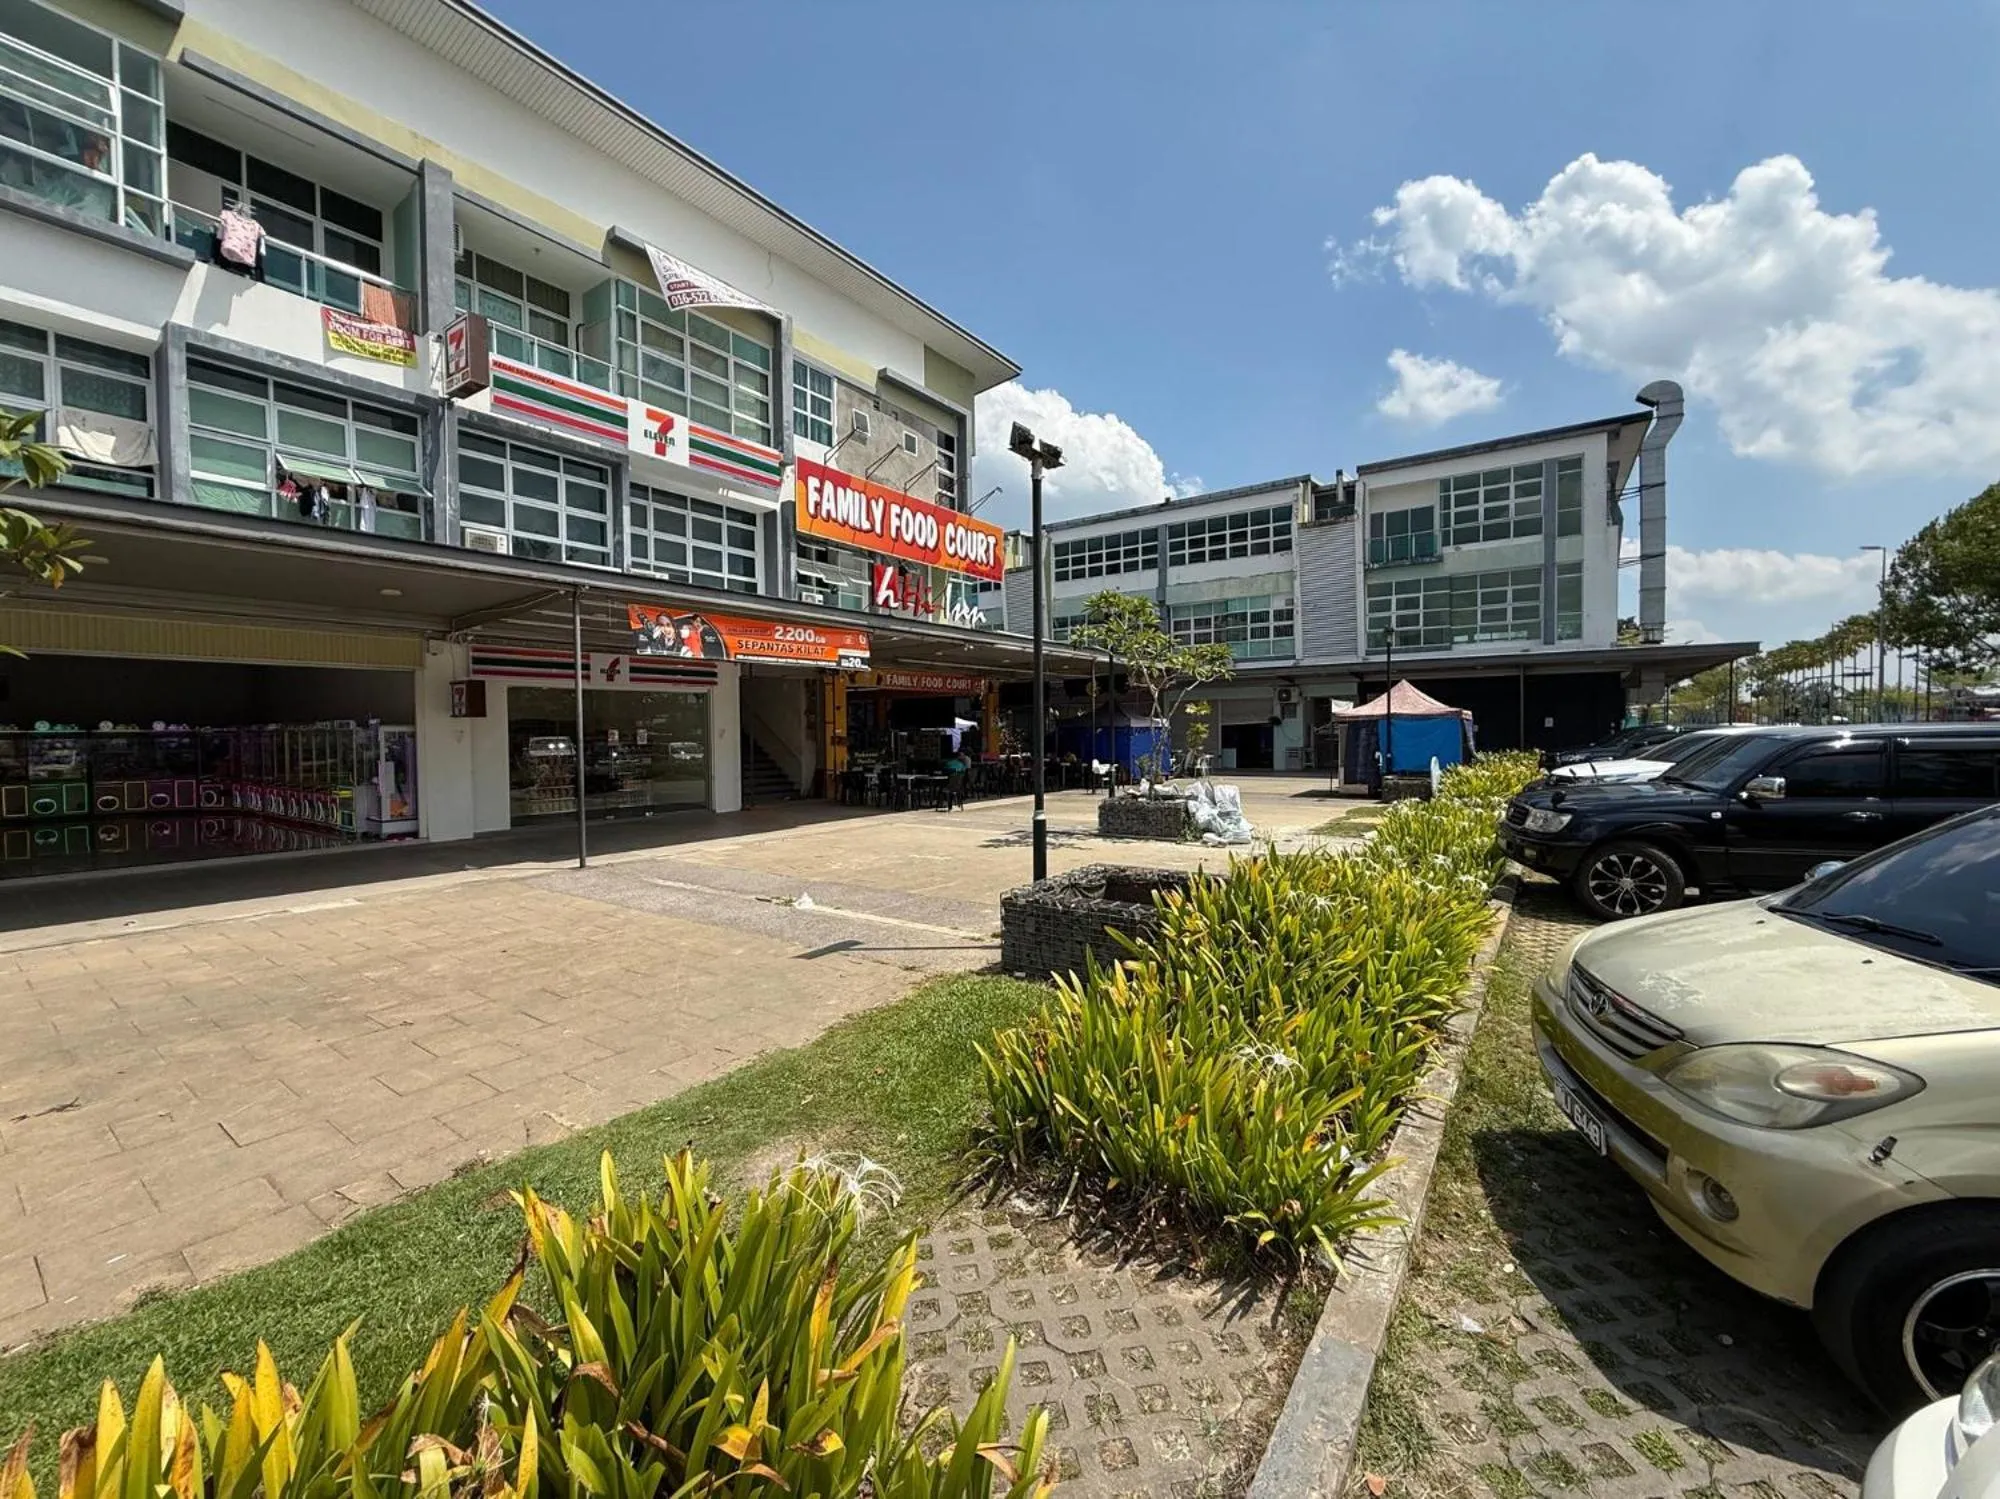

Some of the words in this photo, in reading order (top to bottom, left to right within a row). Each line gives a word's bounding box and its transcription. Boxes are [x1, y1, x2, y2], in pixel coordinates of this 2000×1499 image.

[363, 329, 382, 342] FOR
[807, 475, 885, 538] FAMILY
[889, 503, 938, 550] FOOD
[944, 522, 997, 568] COURT
[737, 640, 793, 653] SEPANTAS
[796, 644, 826, 656] KILAT
[885, 673, 919, 687] FAMILY
[920, 677, 944, 689] FOOD
[945, 679, 972, 690] COURT
